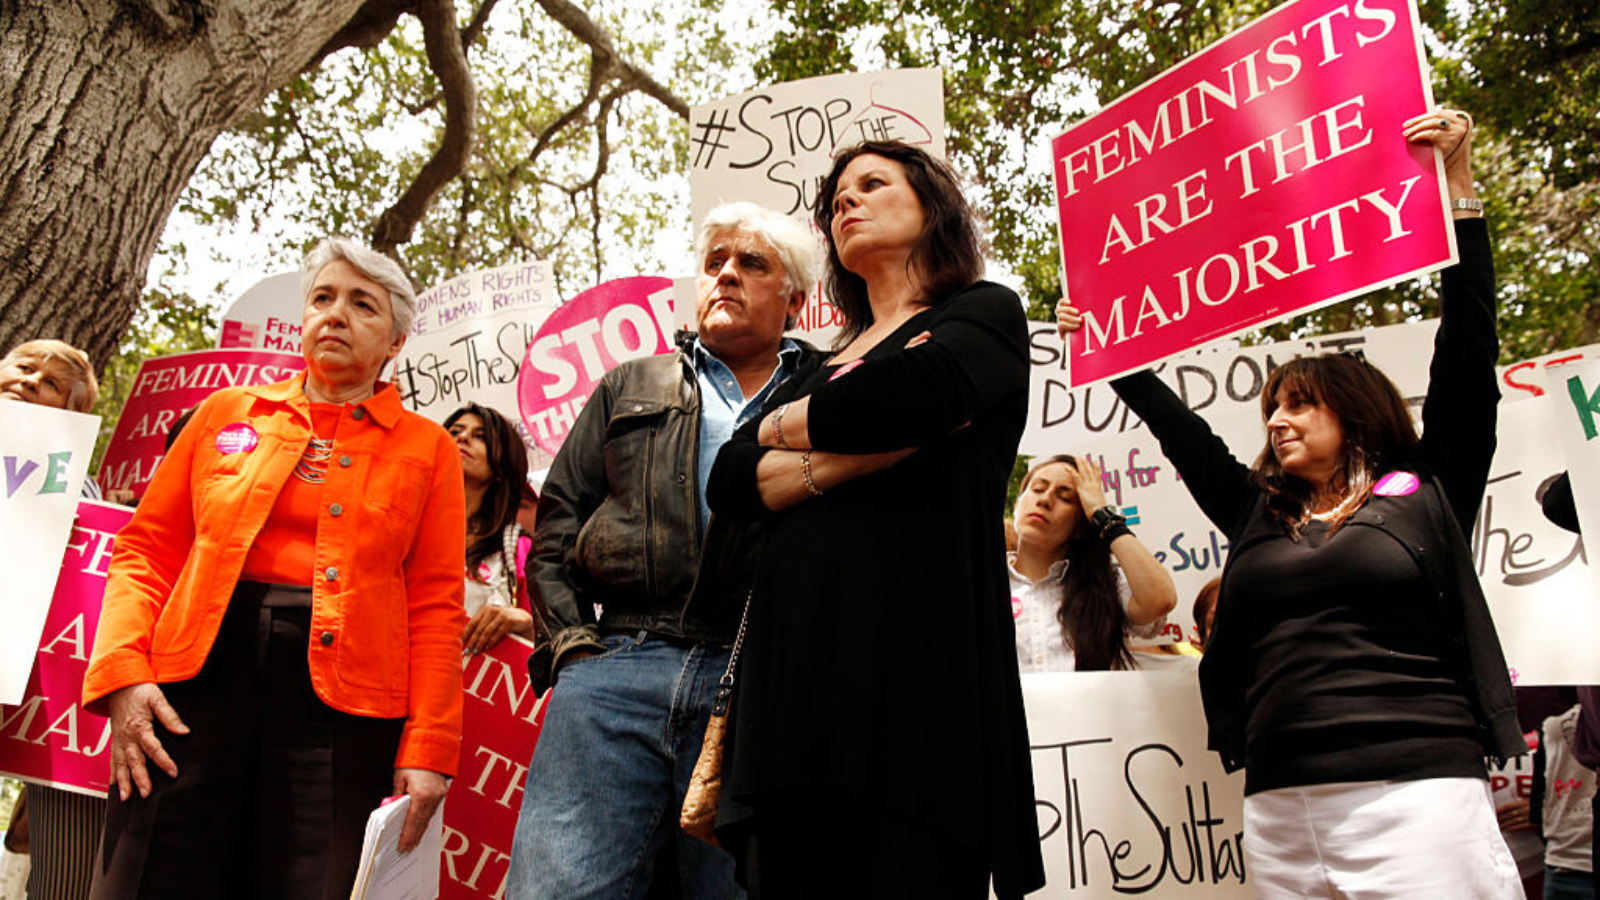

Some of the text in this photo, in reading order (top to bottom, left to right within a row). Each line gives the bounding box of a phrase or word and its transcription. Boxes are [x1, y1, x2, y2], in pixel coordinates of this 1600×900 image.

[1060, 0, 1396, 199] FEMINISTS
[692, 95, 905, 169] #STOP THE
[767, 161, 824, 215] SU
[1098, 95, 1373, 265] ARE THE
[482, 265, 545, 292] RIGHTS
[1079, 175, 1422, 357] MAJORITY
[438, 300, 482, 326] HUMAN
[493, 289, 542, 310] RIGHTS
[127, 408, 190, 440] AR
[1126, 448, 1160, 487] for
